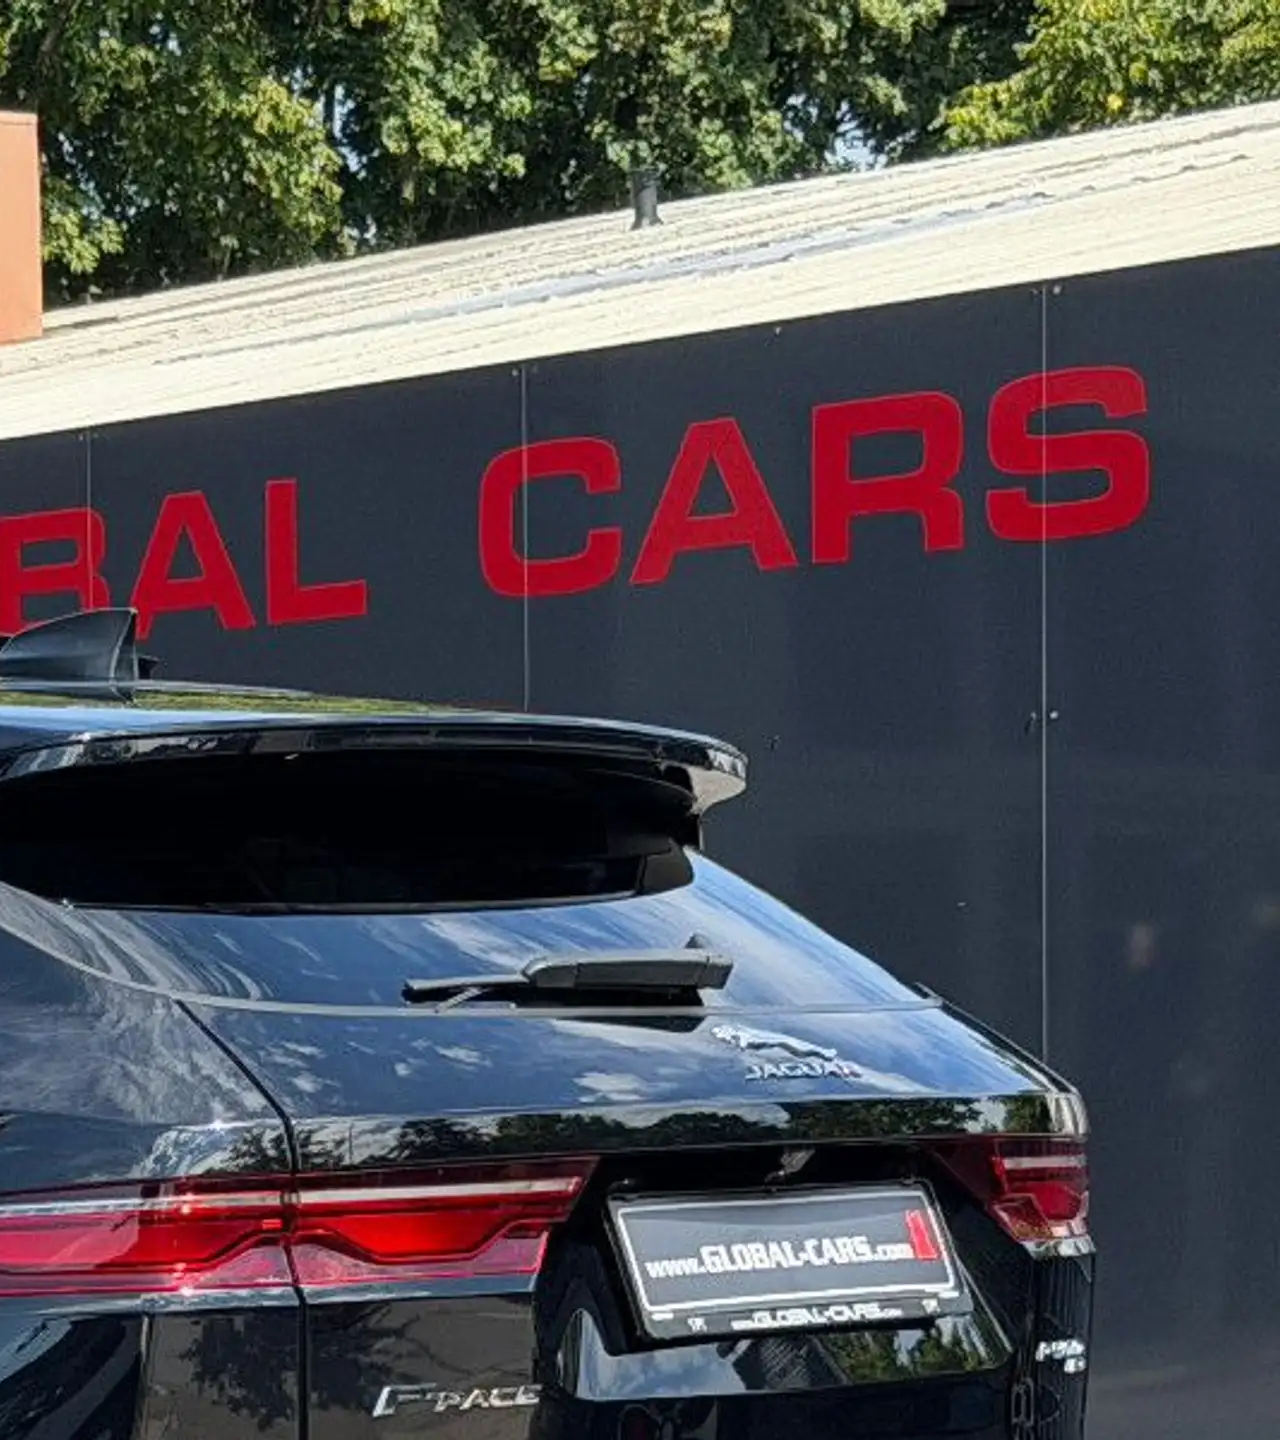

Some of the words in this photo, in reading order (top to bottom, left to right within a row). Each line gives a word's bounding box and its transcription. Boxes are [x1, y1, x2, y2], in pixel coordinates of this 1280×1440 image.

[477, 364, 1151, 597] CARS
[744, 1058, 862, 1080] JAGUAR
[644, 1235, 915, 1279] www.GLOBAL-CARS.com
